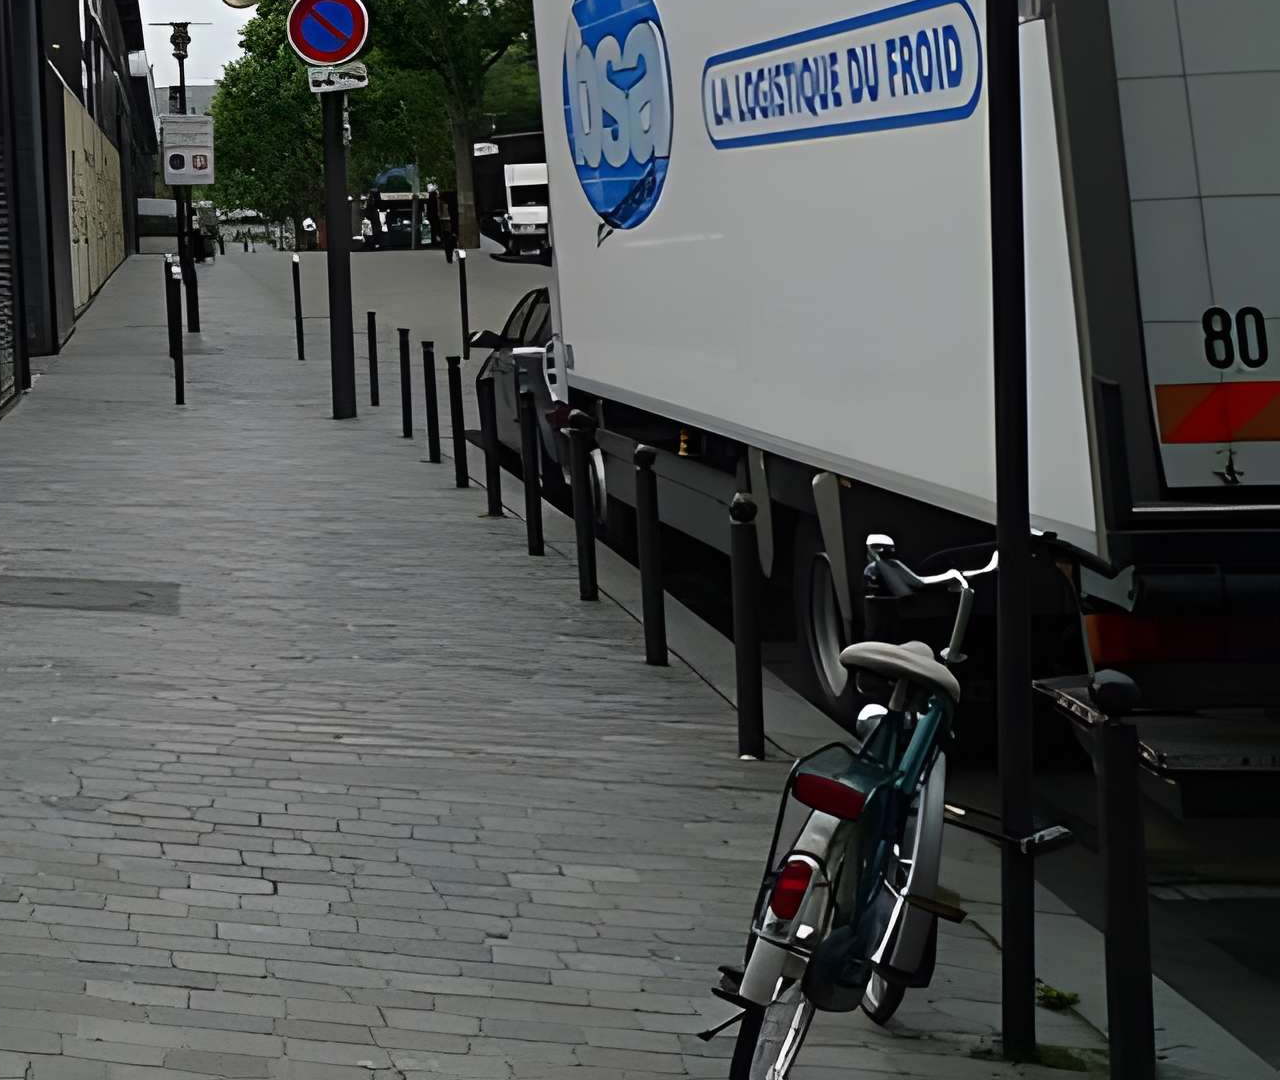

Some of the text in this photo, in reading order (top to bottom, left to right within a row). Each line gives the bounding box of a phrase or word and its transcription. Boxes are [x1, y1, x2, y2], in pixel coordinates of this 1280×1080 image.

[712, 24, 964, 126] LA LOGISTIQUE DU FROID
[1202, 306, 1268, 369] 80
